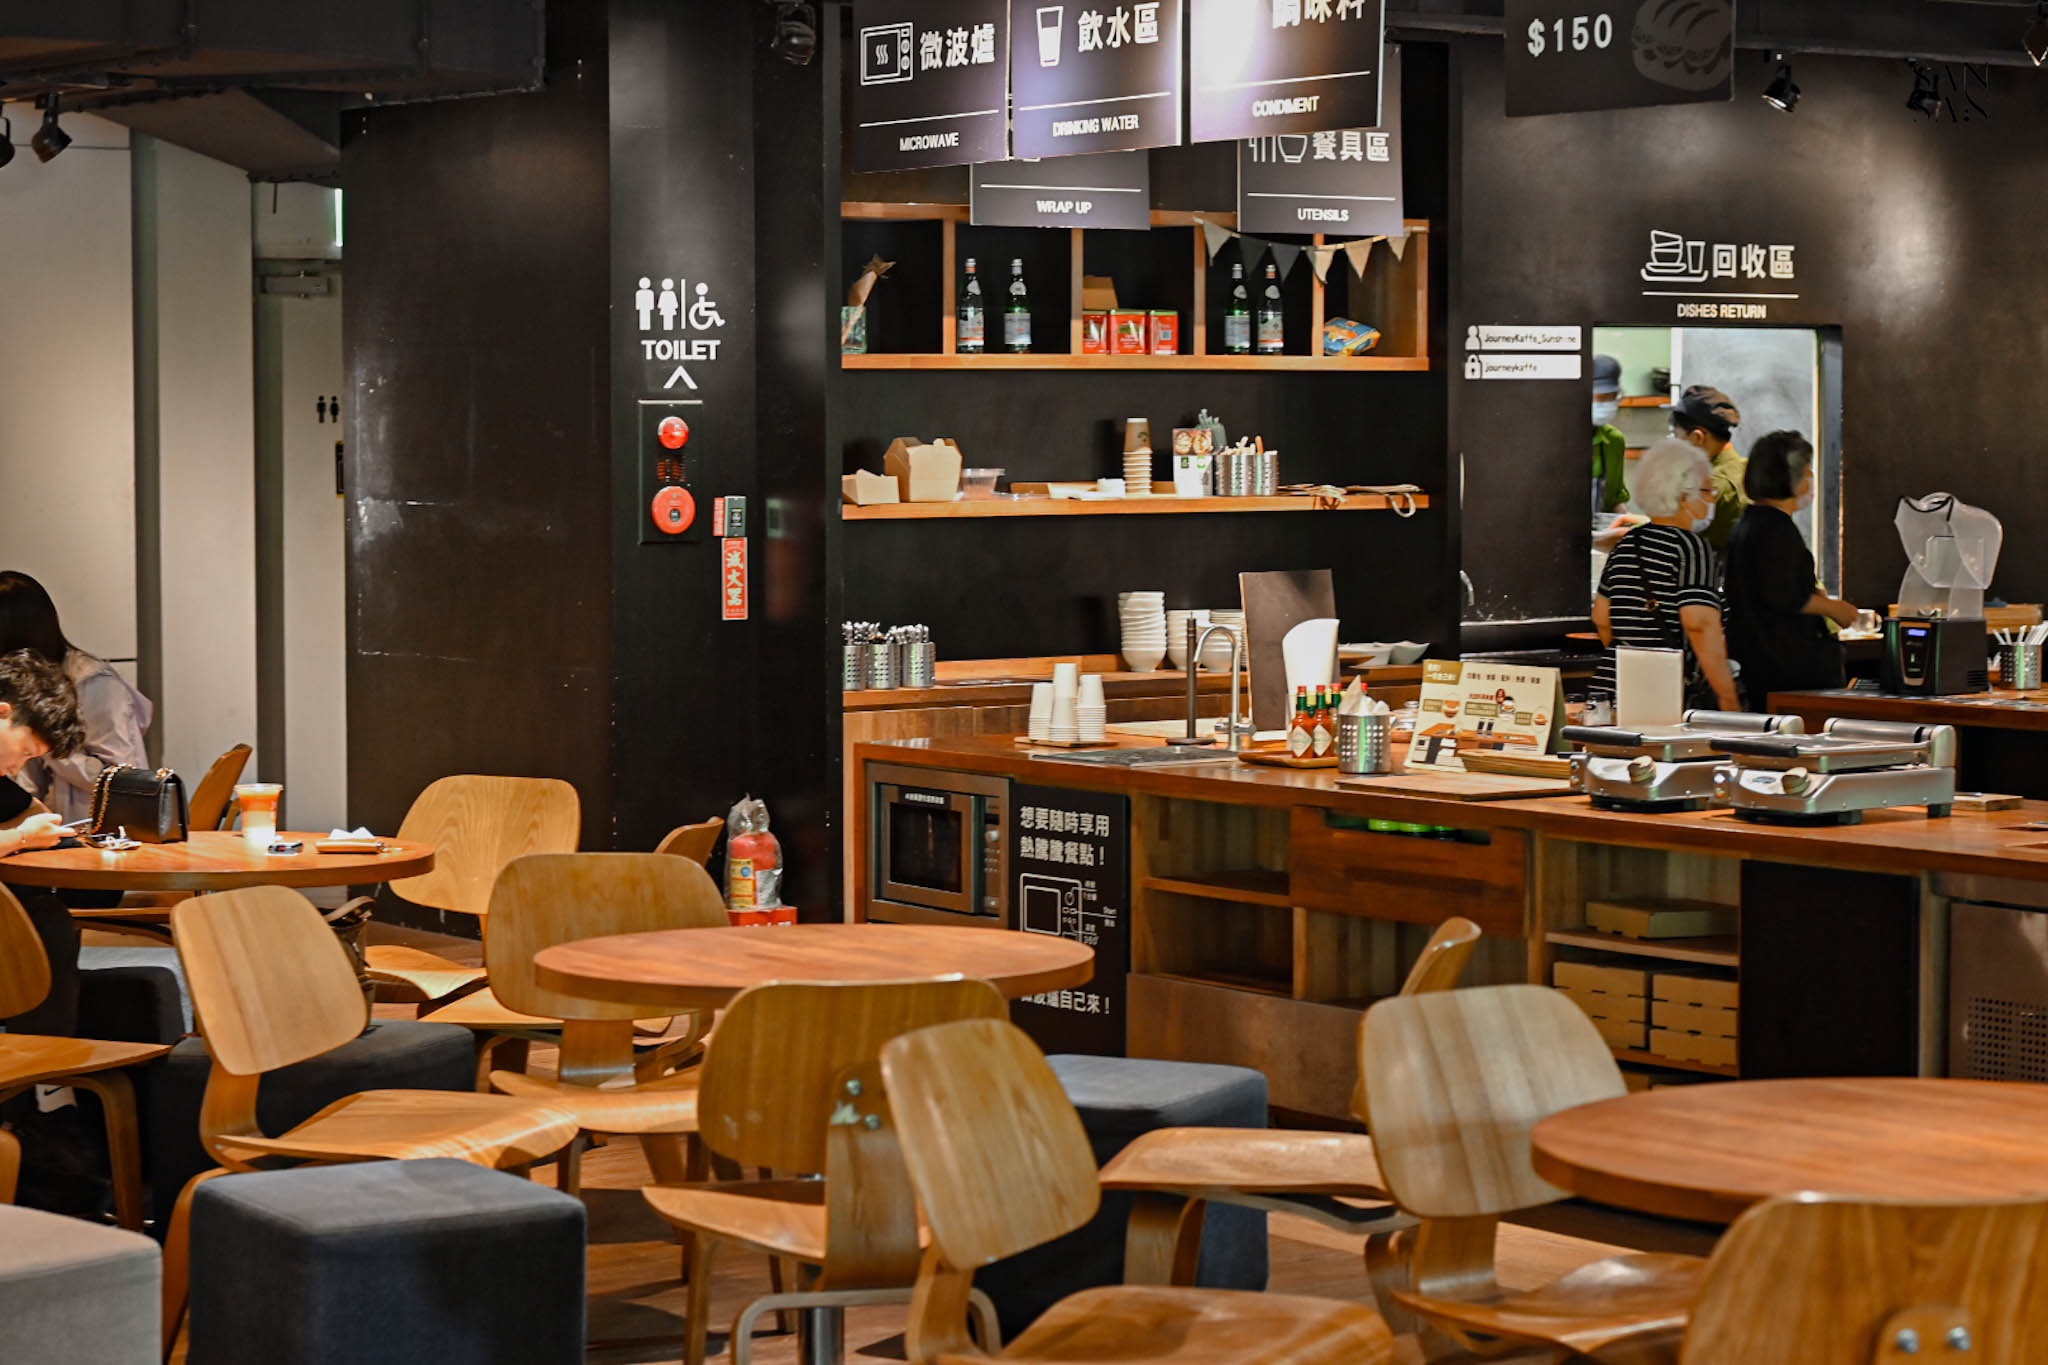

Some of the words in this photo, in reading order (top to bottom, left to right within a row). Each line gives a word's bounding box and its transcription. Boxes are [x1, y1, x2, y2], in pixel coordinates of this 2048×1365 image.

[1077, 3, 1160, 52] 飲水區
[1527, 14, 1613, 57] $150
[919, 23, 995, 72] 微波爐
[1252, 95, 1320, 117] CONDIMENT
[1052, 119, 1098, 137] DRINKING
[1100, 114, 1139, 133] WATER
[899, 132, 959, 151] MICROWAVE
[1311, 131, 1390, 163] 餐具區
[1036, 200, 1072, 214] WRAP
[1074, 201, 1092, 214] UP
[1297, 207, 1349, 222] UTENSILS
[1712, 243, 1796, 279] 回收區
[1676, 303, 1718, 318] DISHES
[1719, 304, 1767, 319] RETURN
[641, 340, 721, 360] TOILET
[1020, 806, 1110, 837] 想要隨時享用
